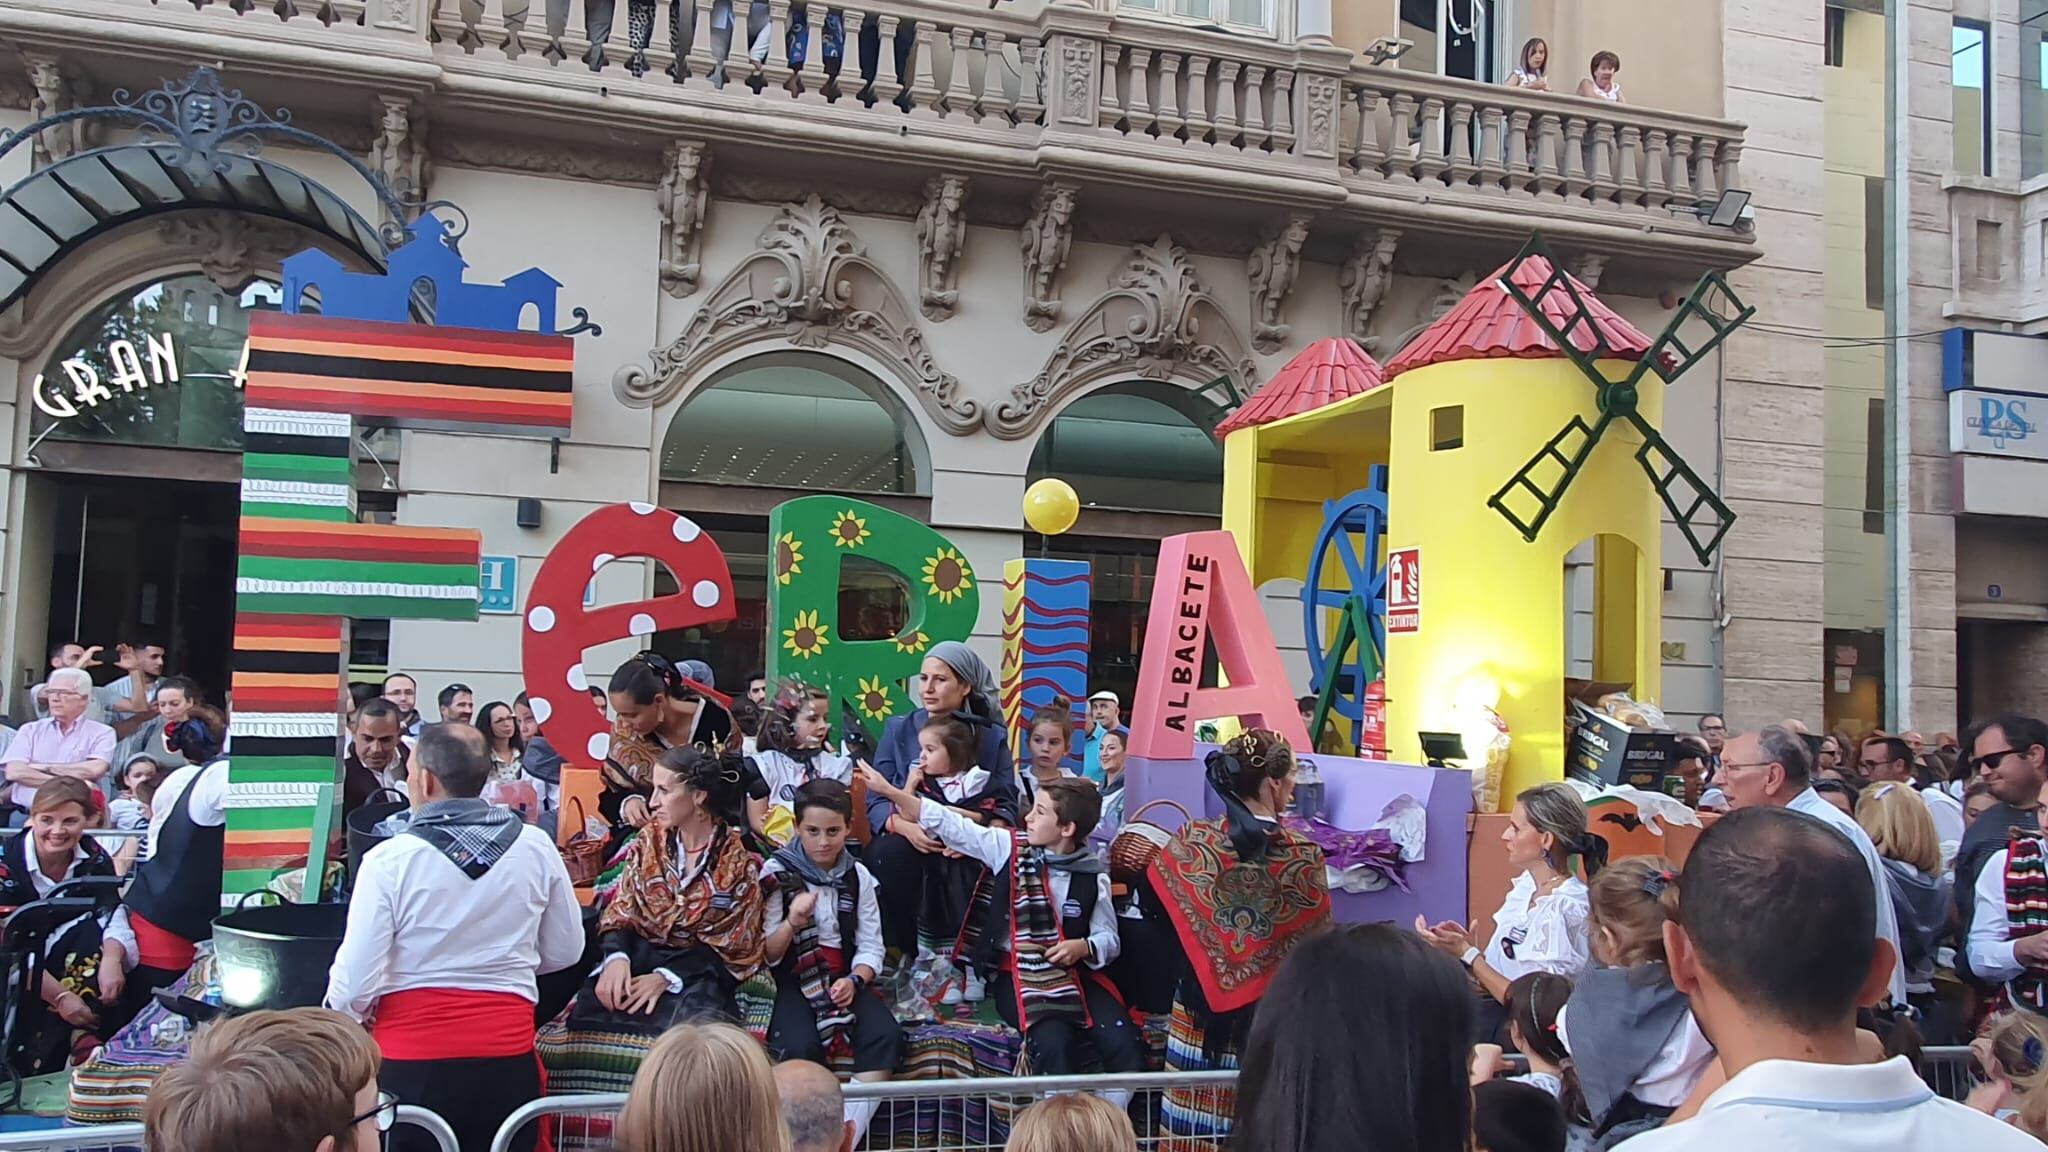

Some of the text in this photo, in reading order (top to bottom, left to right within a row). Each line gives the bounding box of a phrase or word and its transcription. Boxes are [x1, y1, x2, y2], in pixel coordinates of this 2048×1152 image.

[33, 332, 179, 417] GRAN
[480, 561, 505, 590] H
[1165, 554, 1208, 732] ALBACETE
[1626, 750, 1665, 761] BRUGAL
